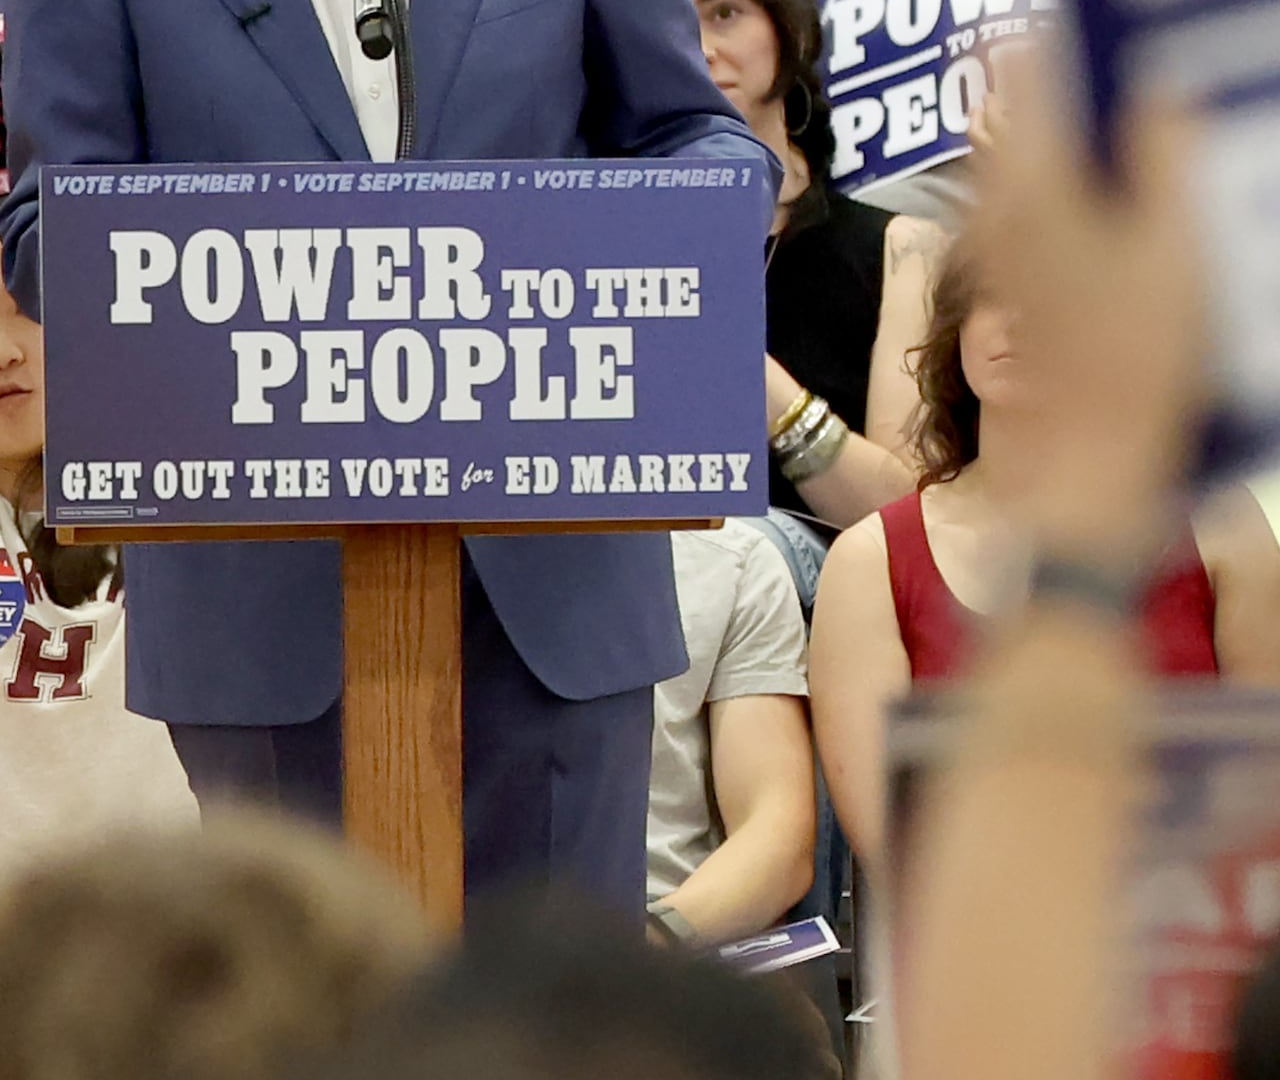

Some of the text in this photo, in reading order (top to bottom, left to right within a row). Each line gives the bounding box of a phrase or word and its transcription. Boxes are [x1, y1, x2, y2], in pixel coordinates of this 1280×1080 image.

[946, 18, 1029, 56] TO THE
[829, 57, 992, 180] PEO
[52, 168, 751, 195] VOTE SEPTEMBER 1 VOTE SEPTEMBER 1 VOTE SEPTEMBER 1
[108, 225, 702, 324] POWER TO THE
[230, 325, 636, 425] PEOPLE
[61, 452, 752, 502] GET OUT THE VOTE for ED MARKEY
[4, 616, 98, 703] H
